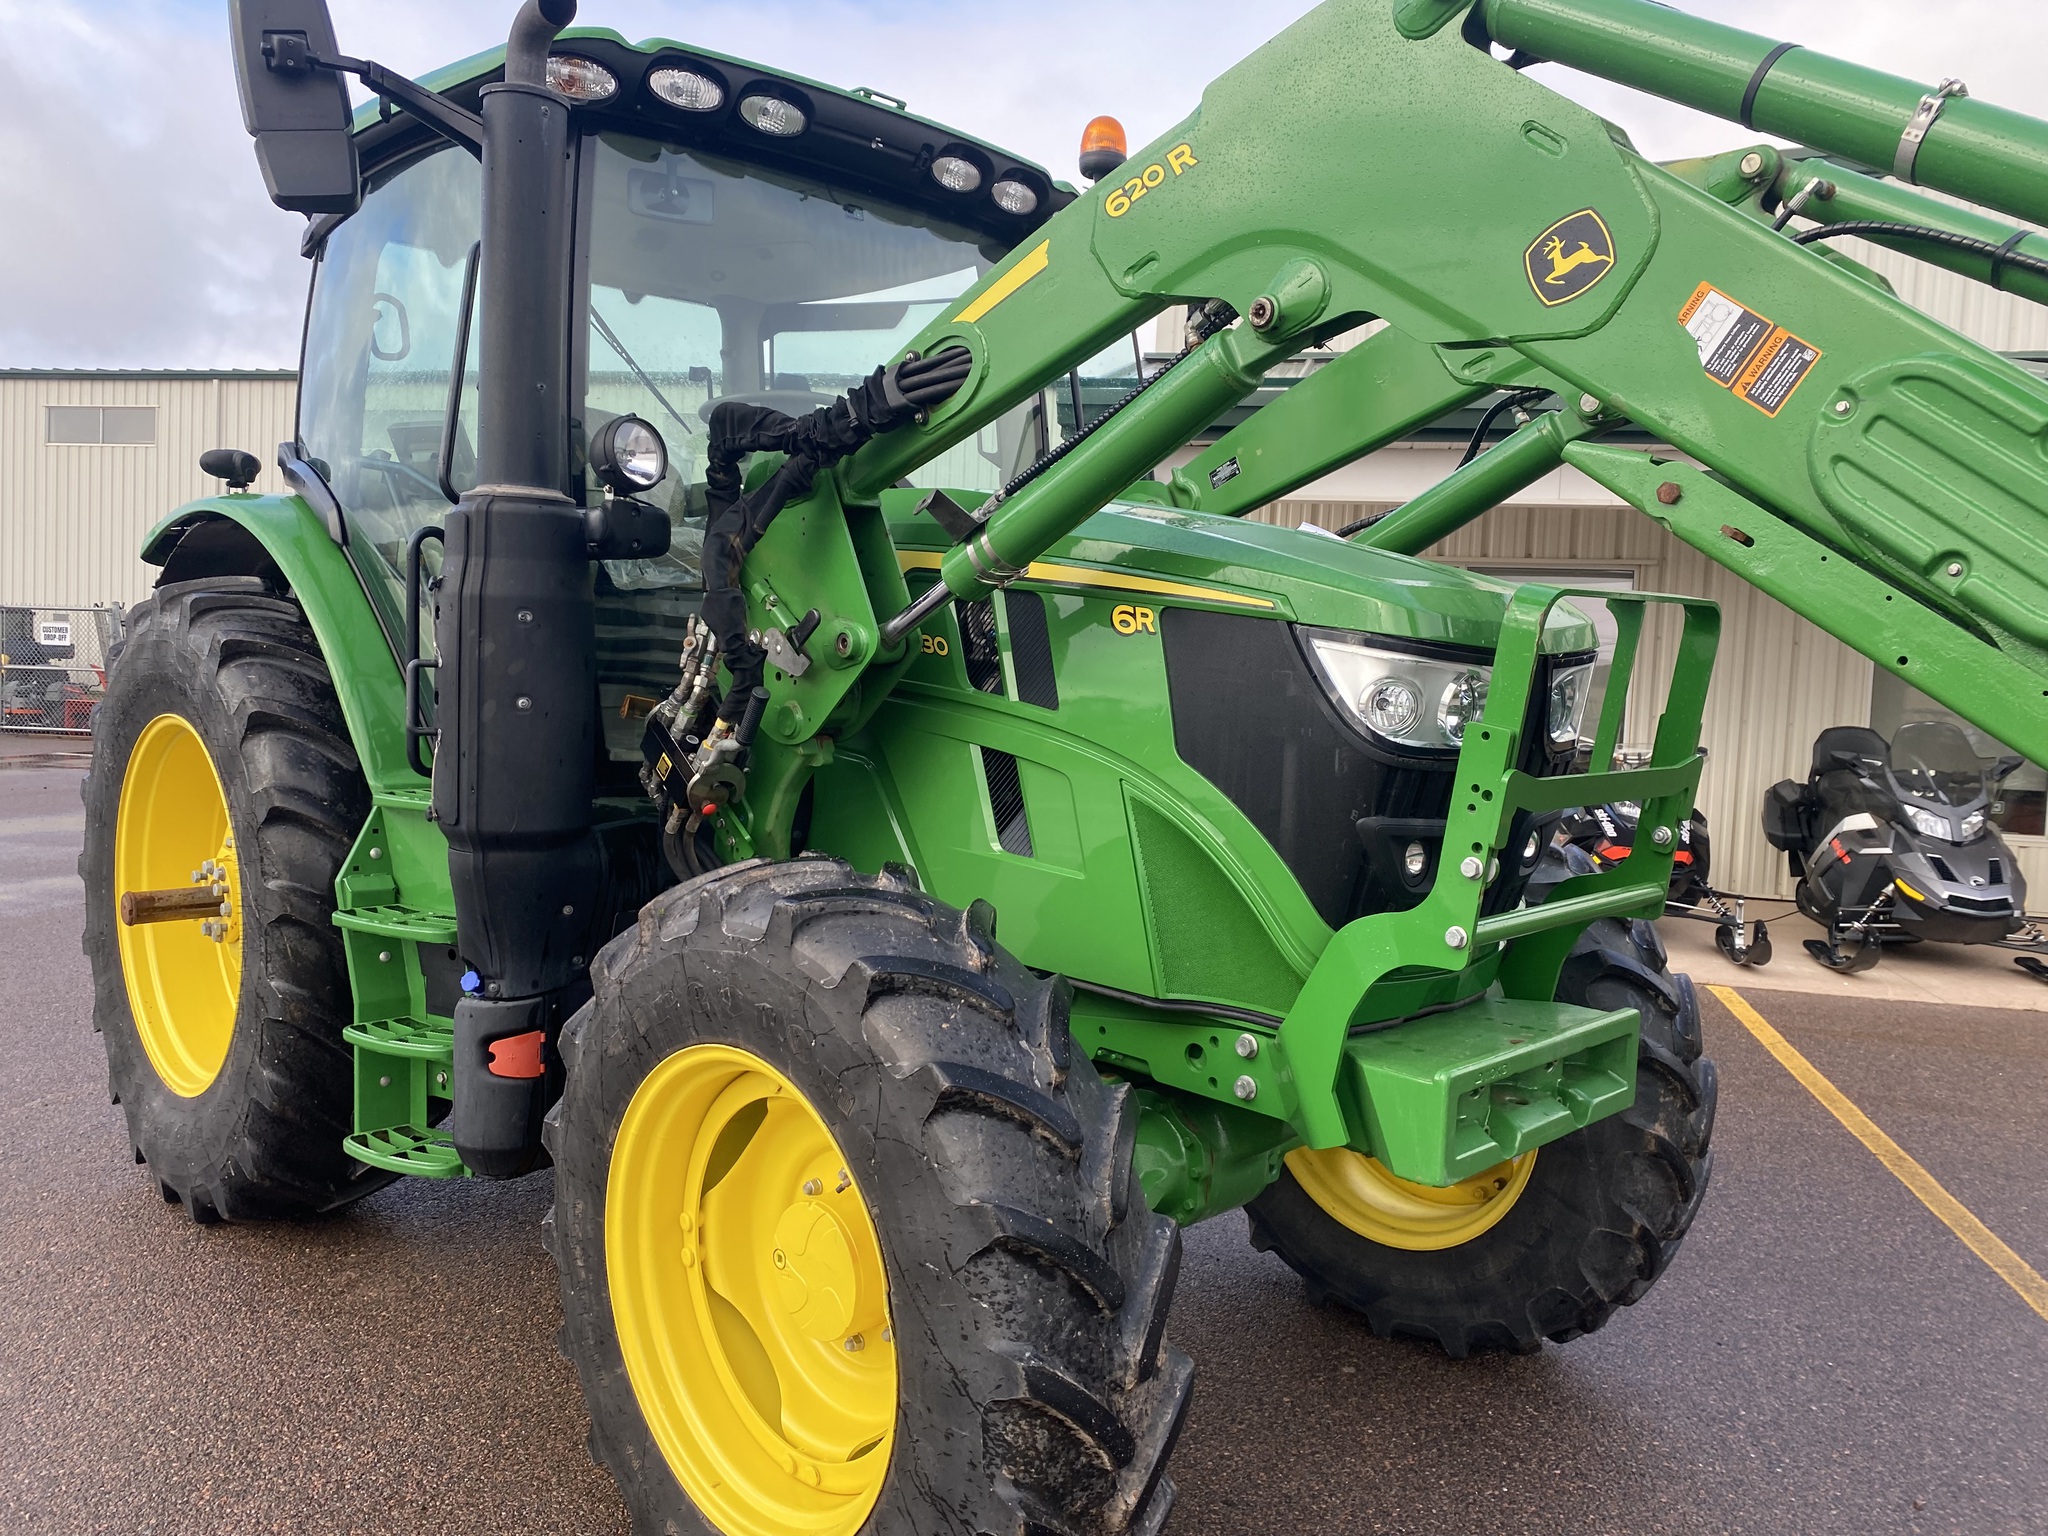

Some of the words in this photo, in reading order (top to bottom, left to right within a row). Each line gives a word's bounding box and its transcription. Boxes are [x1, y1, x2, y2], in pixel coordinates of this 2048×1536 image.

[1104, 163, 1166, 218] 620
[1165, 142, 1200, 177] R
[1678, 289, 1705, 326] ARNING
[1748, 336, 1783, 379] WARNING
[42, 626, 69, 634] CUSTOMER
[1111, 604, 1156, 636] 6R
[43, 633, 67, 642] DROP-OFF
[920, 634, 949, 657] 30
